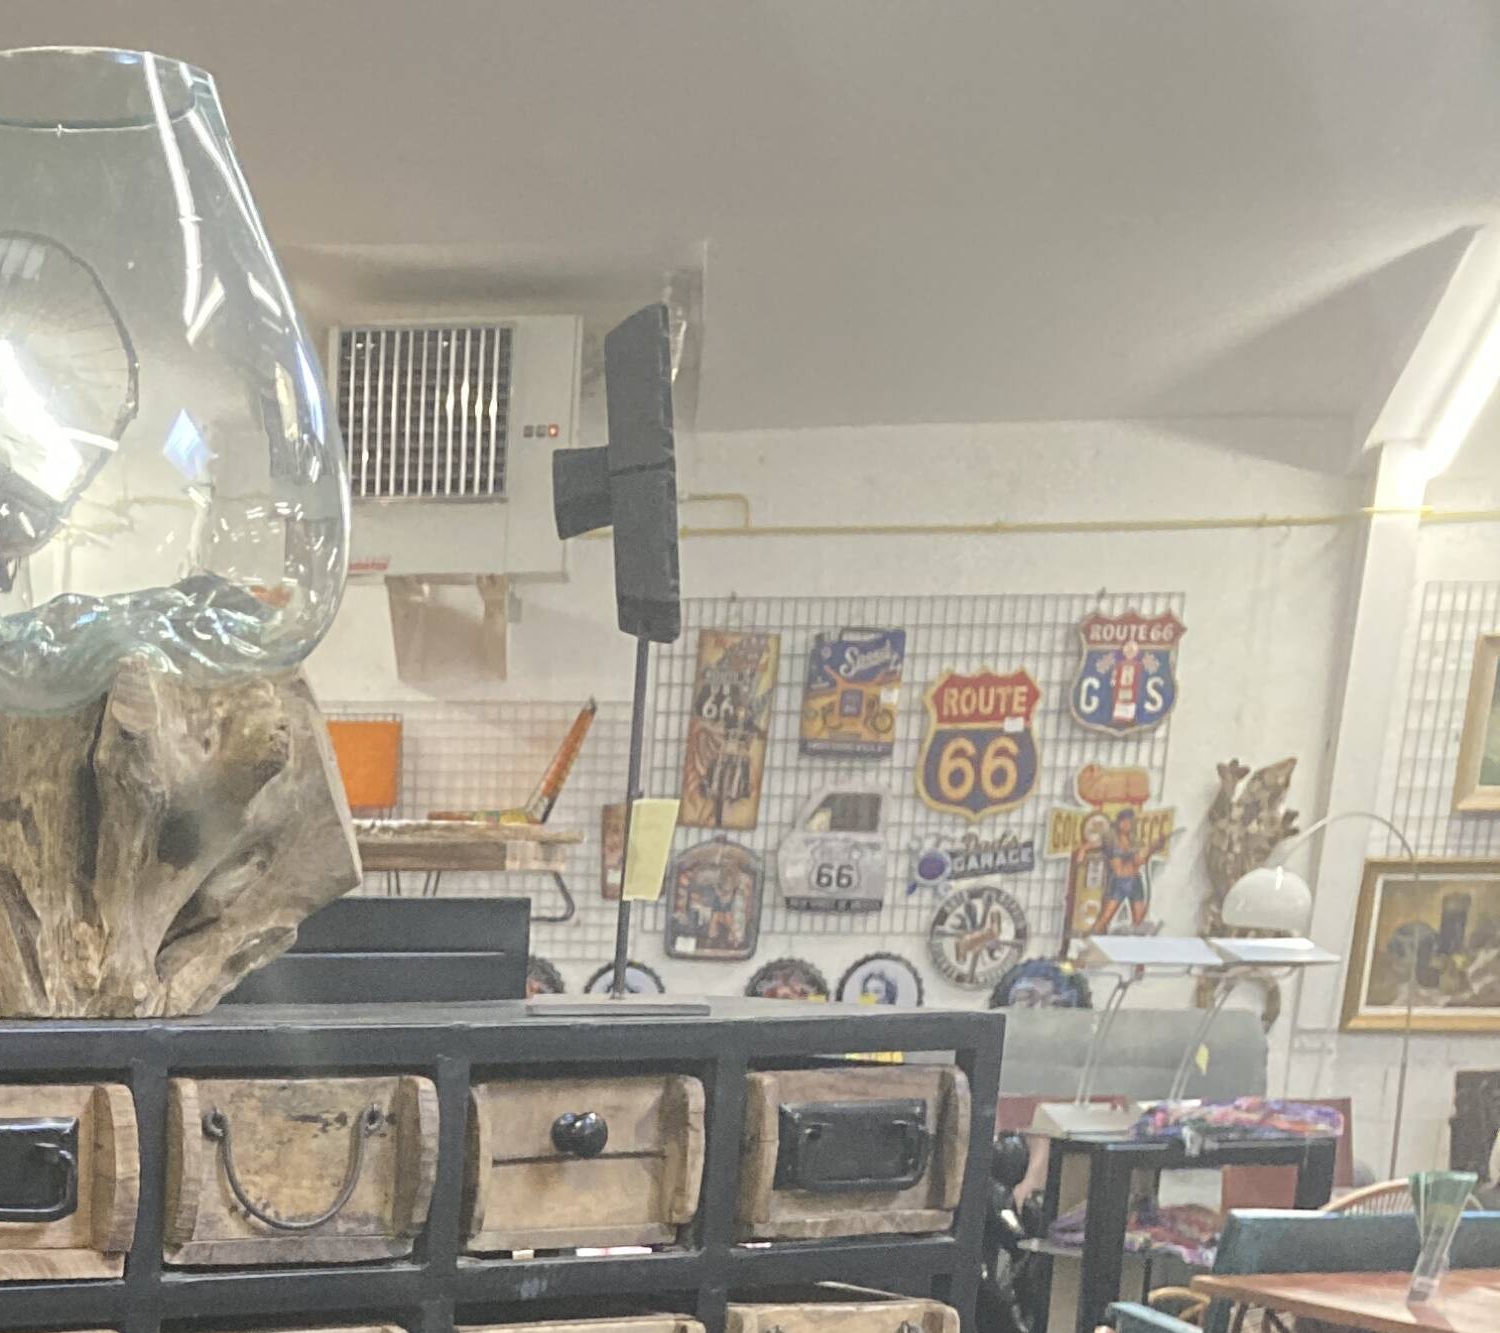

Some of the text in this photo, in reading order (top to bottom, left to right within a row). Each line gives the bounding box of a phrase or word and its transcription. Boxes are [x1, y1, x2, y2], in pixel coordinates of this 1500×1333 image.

[1089, 622, 1174, 641] ROUTE 66
[942, 685, 1028, 716] ROUTE
[938, 736, 1018, 800] 66
[816, 863, 854, 889] 66
